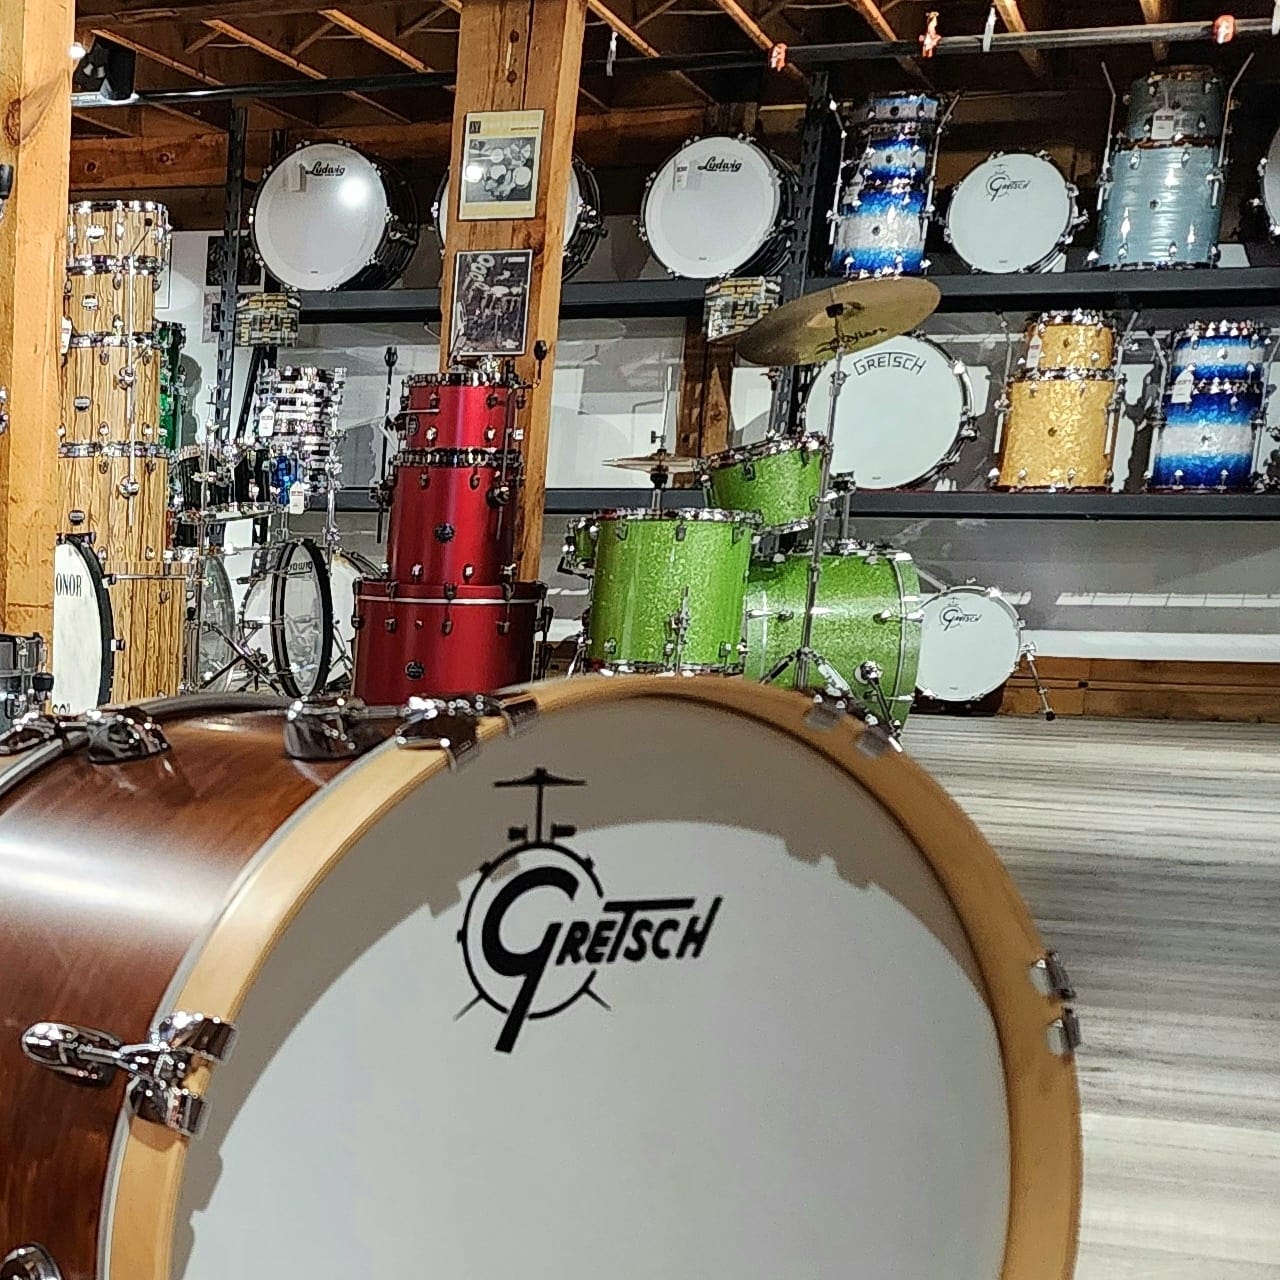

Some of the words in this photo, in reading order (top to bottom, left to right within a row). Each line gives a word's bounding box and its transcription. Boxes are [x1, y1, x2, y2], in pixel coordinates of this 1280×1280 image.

[698, 156, 742, 173] Ludwig
[853, 352, 927, 376] GRETSCH
[55, 572, 82, 597] ONOR
[482, 866, 723, 1054] GRETSCH
